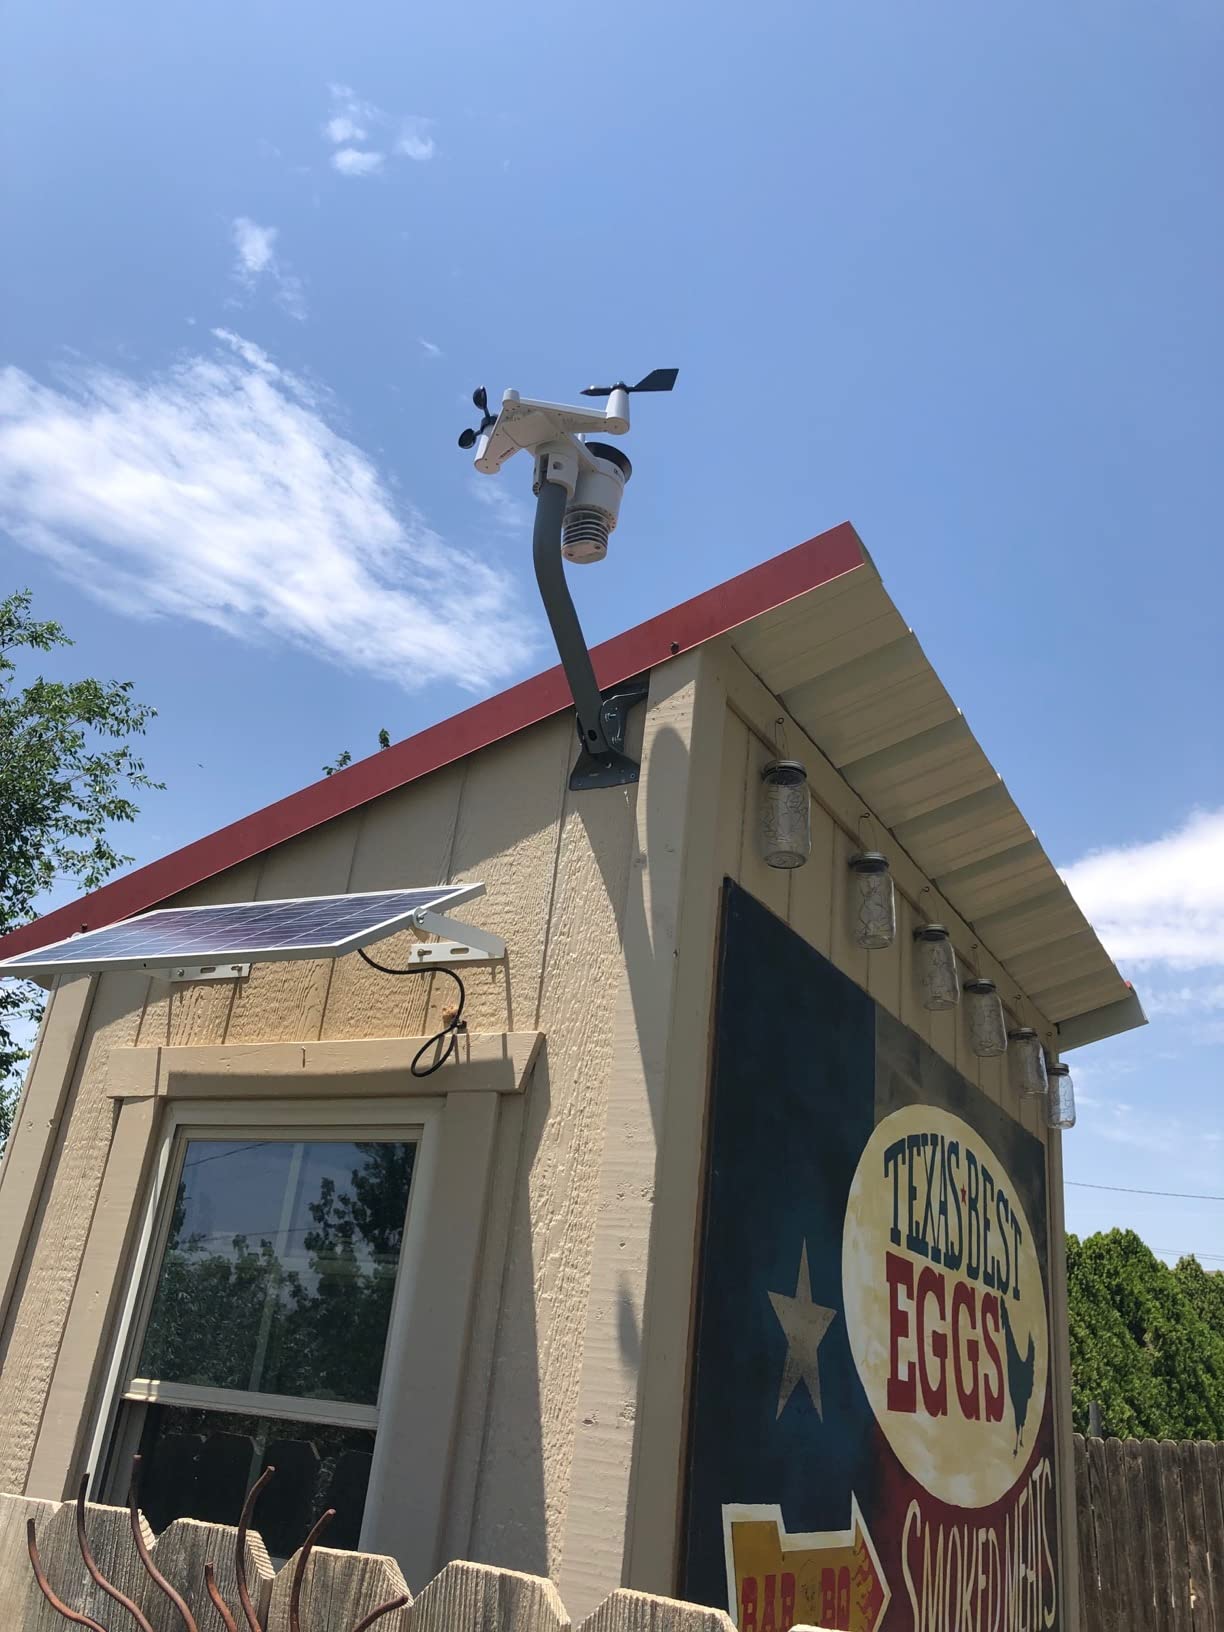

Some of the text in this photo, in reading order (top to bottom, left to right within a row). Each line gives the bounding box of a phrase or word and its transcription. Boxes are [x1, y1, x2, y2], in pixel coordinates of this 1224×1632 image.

[884, 1133, 1022, 1301] TEXAS BEST
[886, 1251, 1004, 1422] EGGS
[741, 1572, 796, 1632] BAR
[902, 1457, 1056, 1632] SMOKED MEATS
